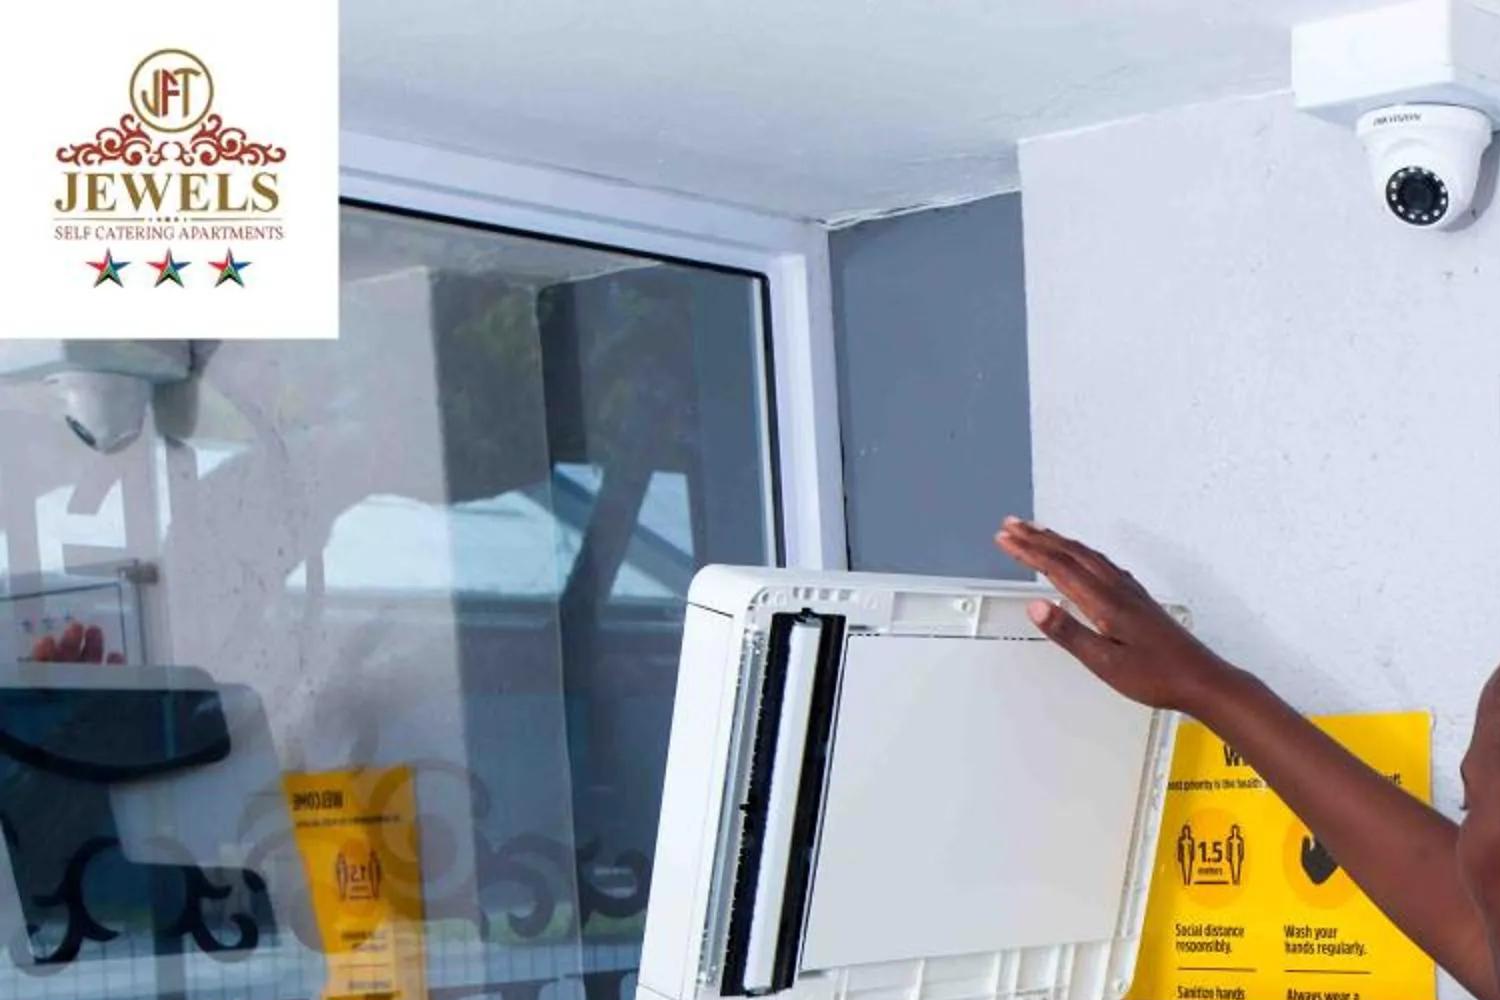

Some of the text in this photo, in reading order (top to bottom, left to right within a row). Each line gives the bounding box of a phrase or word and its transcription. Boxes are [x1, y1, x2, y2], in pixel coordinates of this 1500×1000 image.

[1197, 841, 1223, 863] 1.5
[1175, 923, 1245, 938] Social distance
[1284, 925, 1338, 941] Wash your
[1175, 939, 1232, 955] responsibly.
[1285, 941, 1368, 957] hands regularly.
[1215, 987, 1246, 1000] hands
